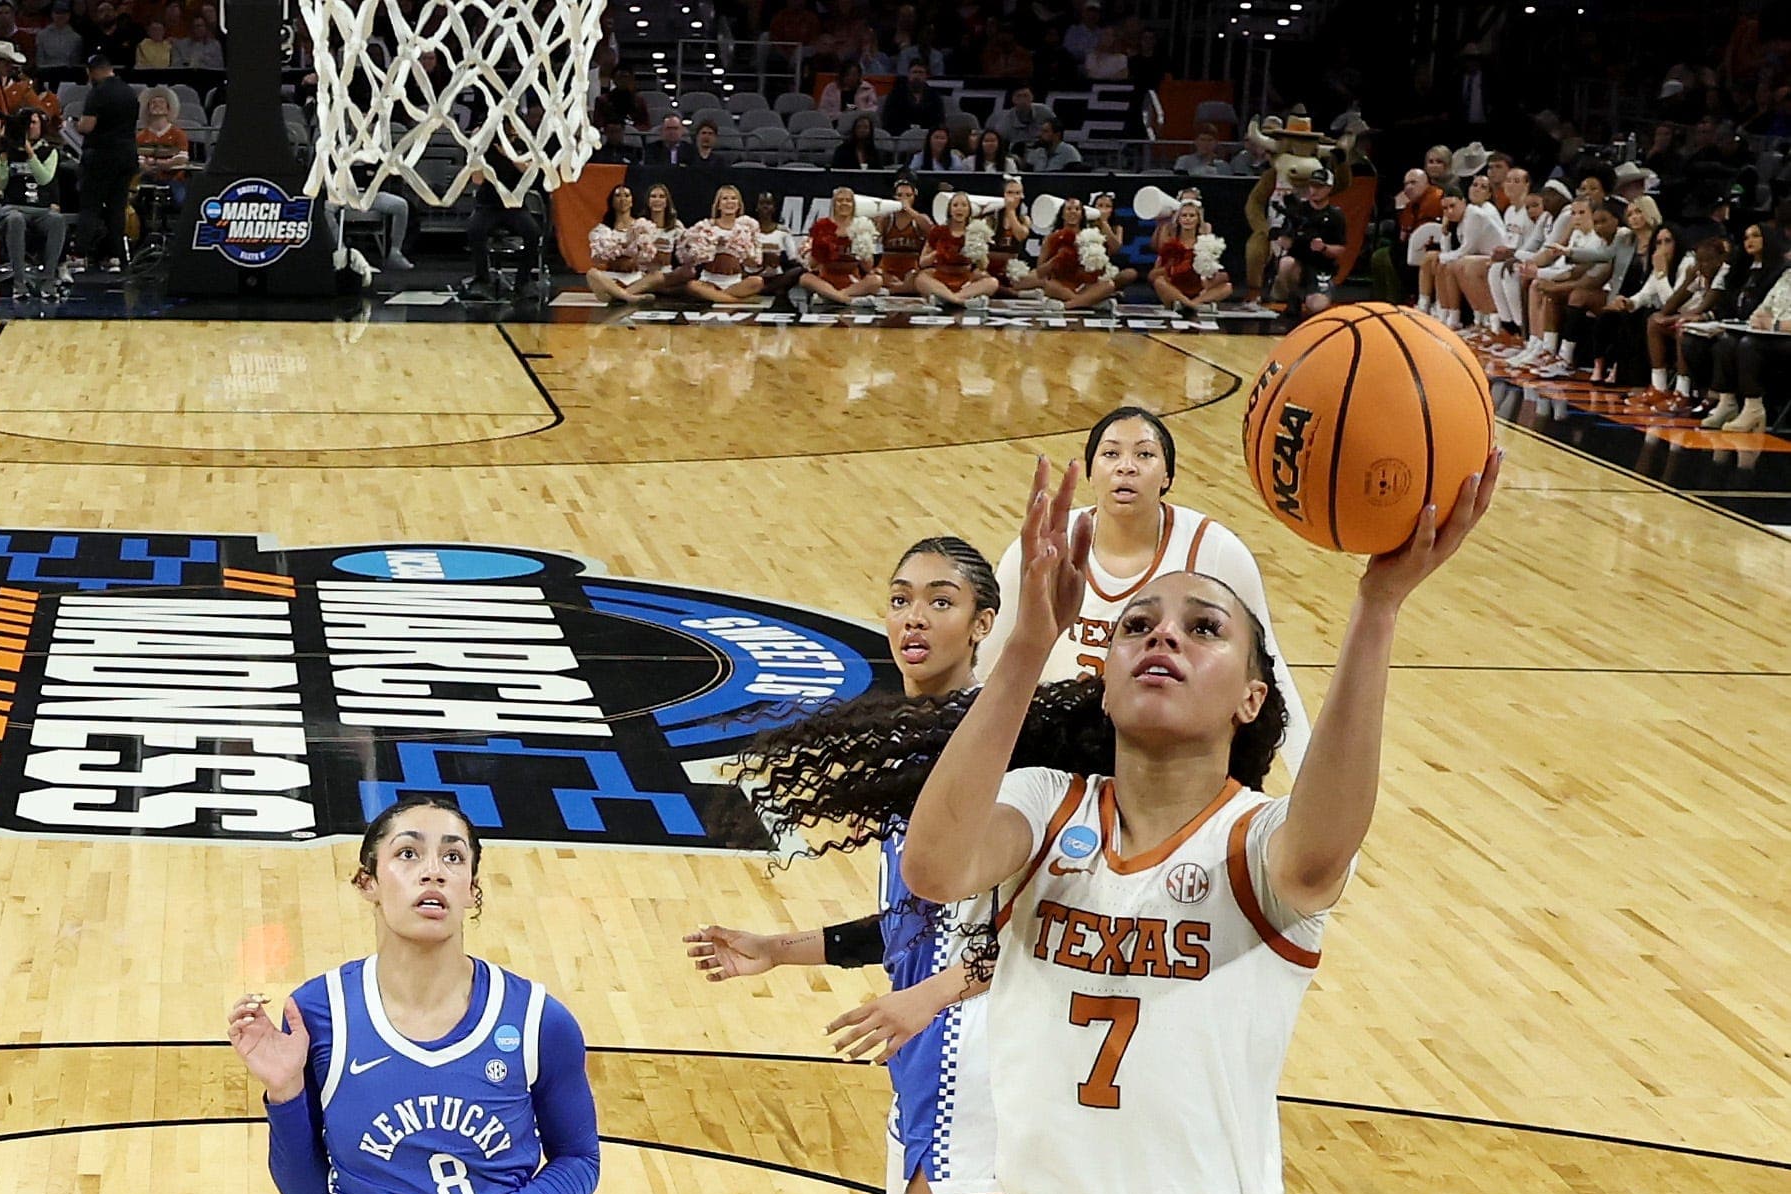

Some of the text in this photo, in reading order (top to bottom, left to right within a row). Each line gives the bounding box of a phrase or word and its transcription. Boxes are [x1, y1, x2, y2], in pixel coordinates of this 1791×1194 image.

[222, 203, 282, 220] MARCH
[228, 221, 308, 239] MADNESS
[630, 310, 1220, 330] SWEET SIXTEEN
[1272, 402, 1313, 522] NCAA
[315, 580, 614, 737] MARCH
[680, 617, 846, 697] SWEET 16
[1068, 617, 1118, 648] TEX
[15, 596, 316, 832] MADNESS
[1167, 863, 1209, 903] SEC
[1033, 899, 1211, 981] TEXAS
[487, 1061, 507, 1080] SEC
[1068, 991, 1141, 1110] 7
[359, 1095, 512, 1161] KENTUCKY
